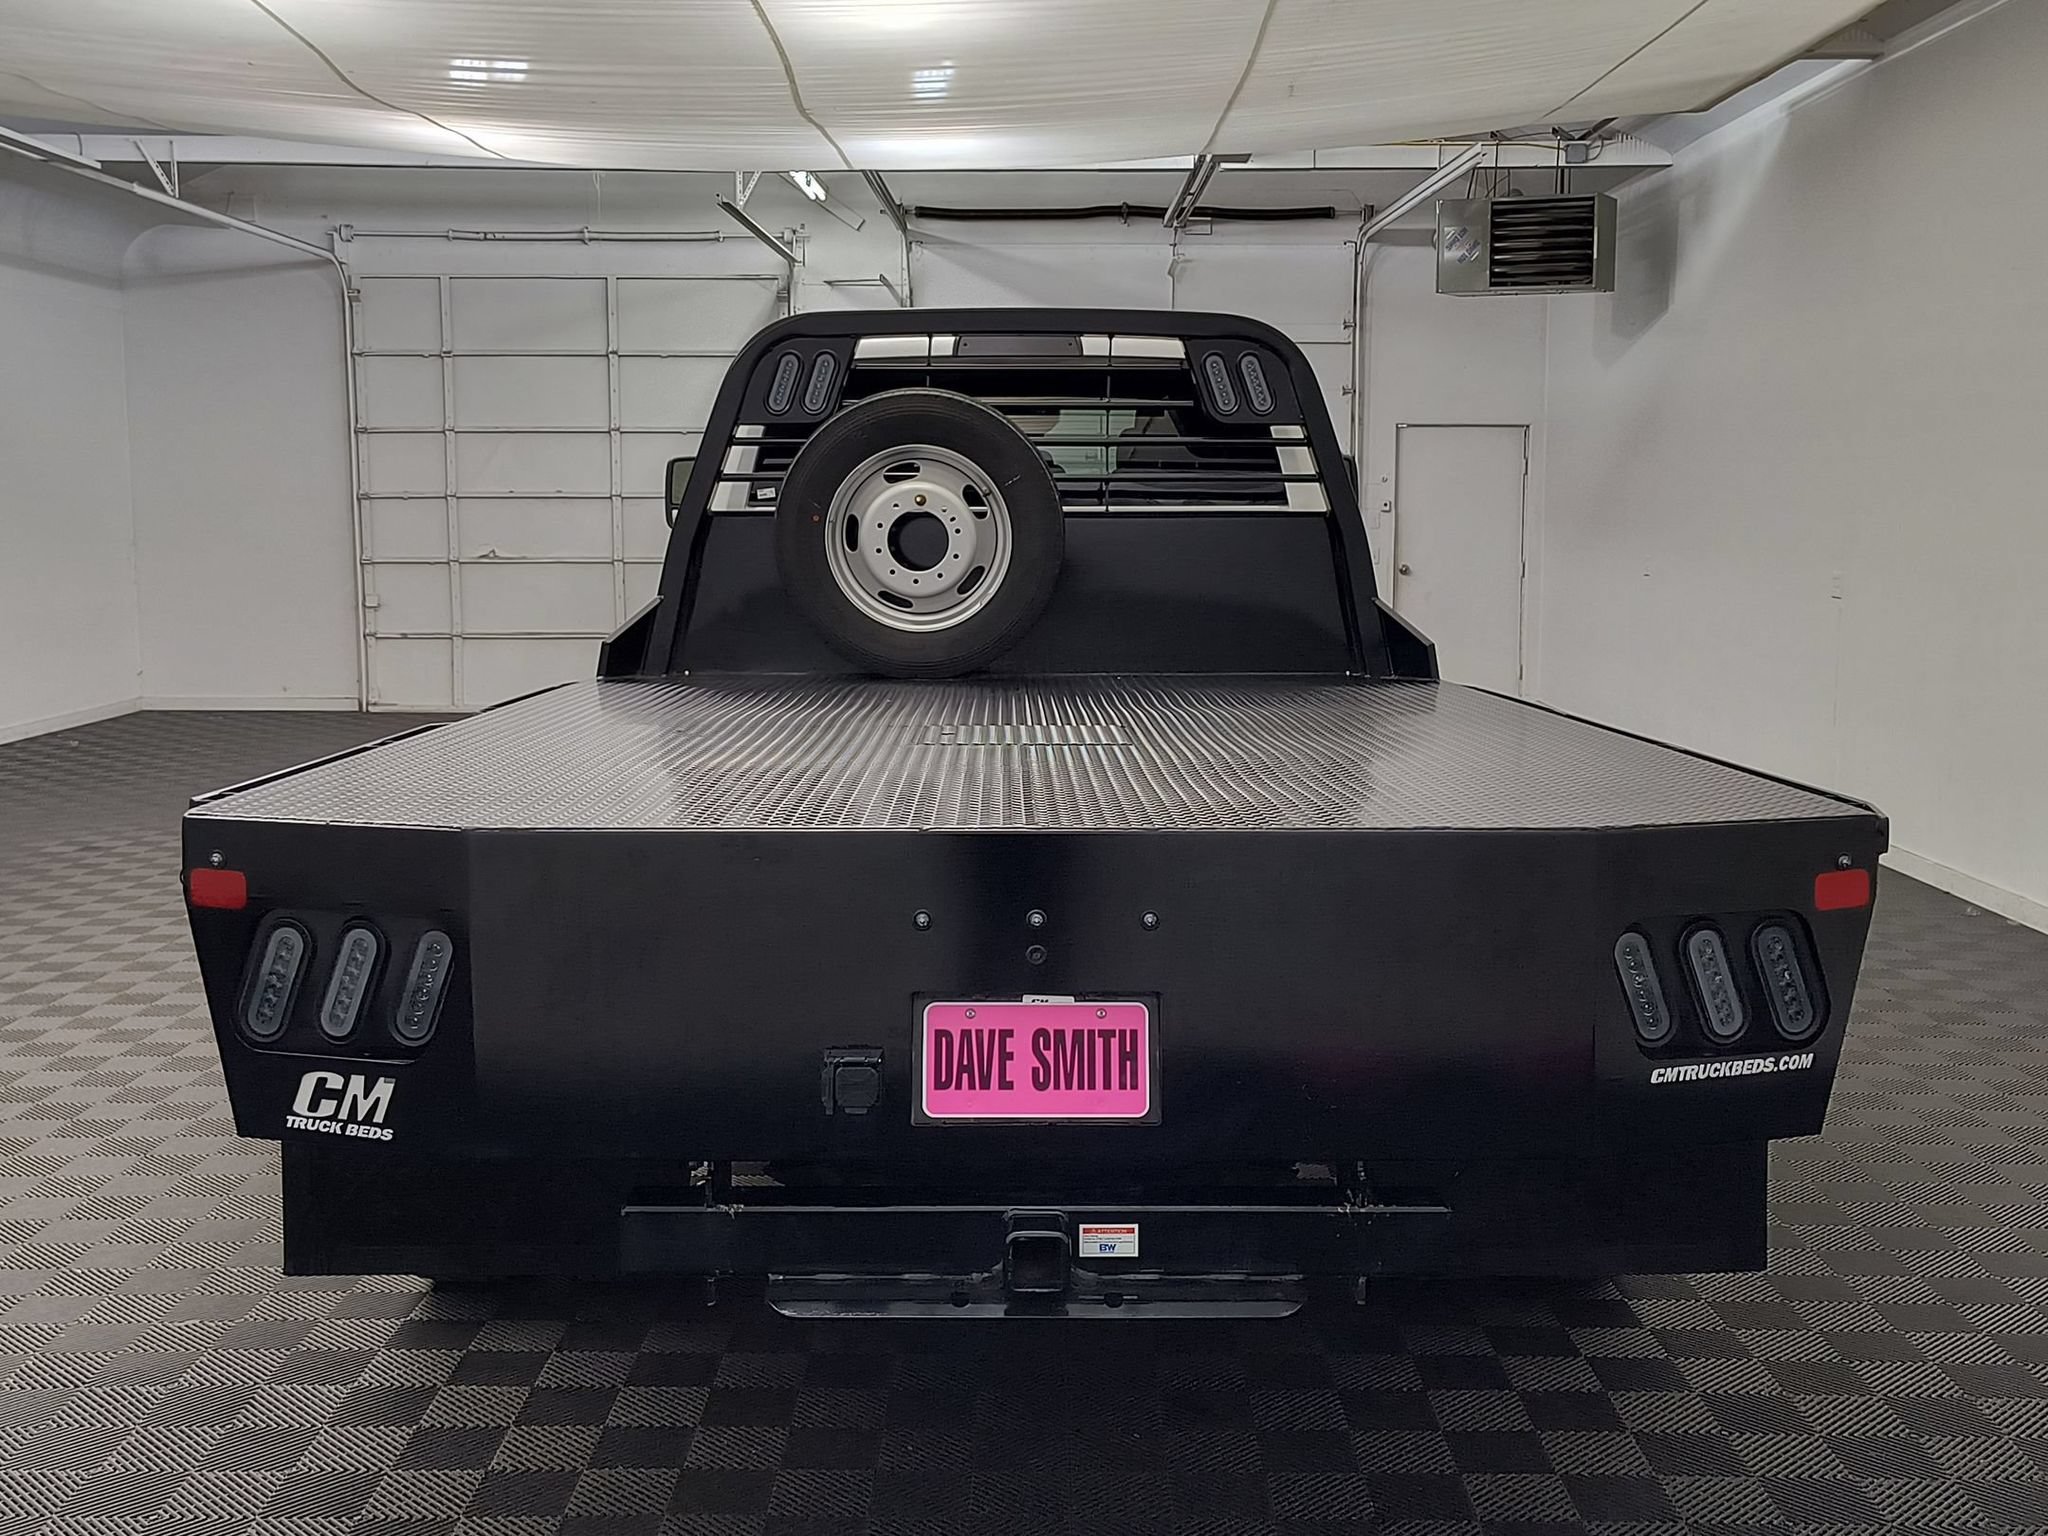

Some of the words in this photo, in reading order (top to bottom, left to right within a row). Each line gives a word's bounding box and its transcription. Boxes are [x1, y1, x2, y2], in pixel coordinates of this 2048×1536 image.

[933, 1028, 1015, 1091] DAVE
[1031, 1027, 1139, 1092] SMITH
[1650, 1053, 1814, 1084] CMTRUCKBEDS.COM
[292, 1071, 396, 1124] CM
[286, 1115, 344, 1135] TRUCK
[345, 1123, 394, 1141] BEDS
